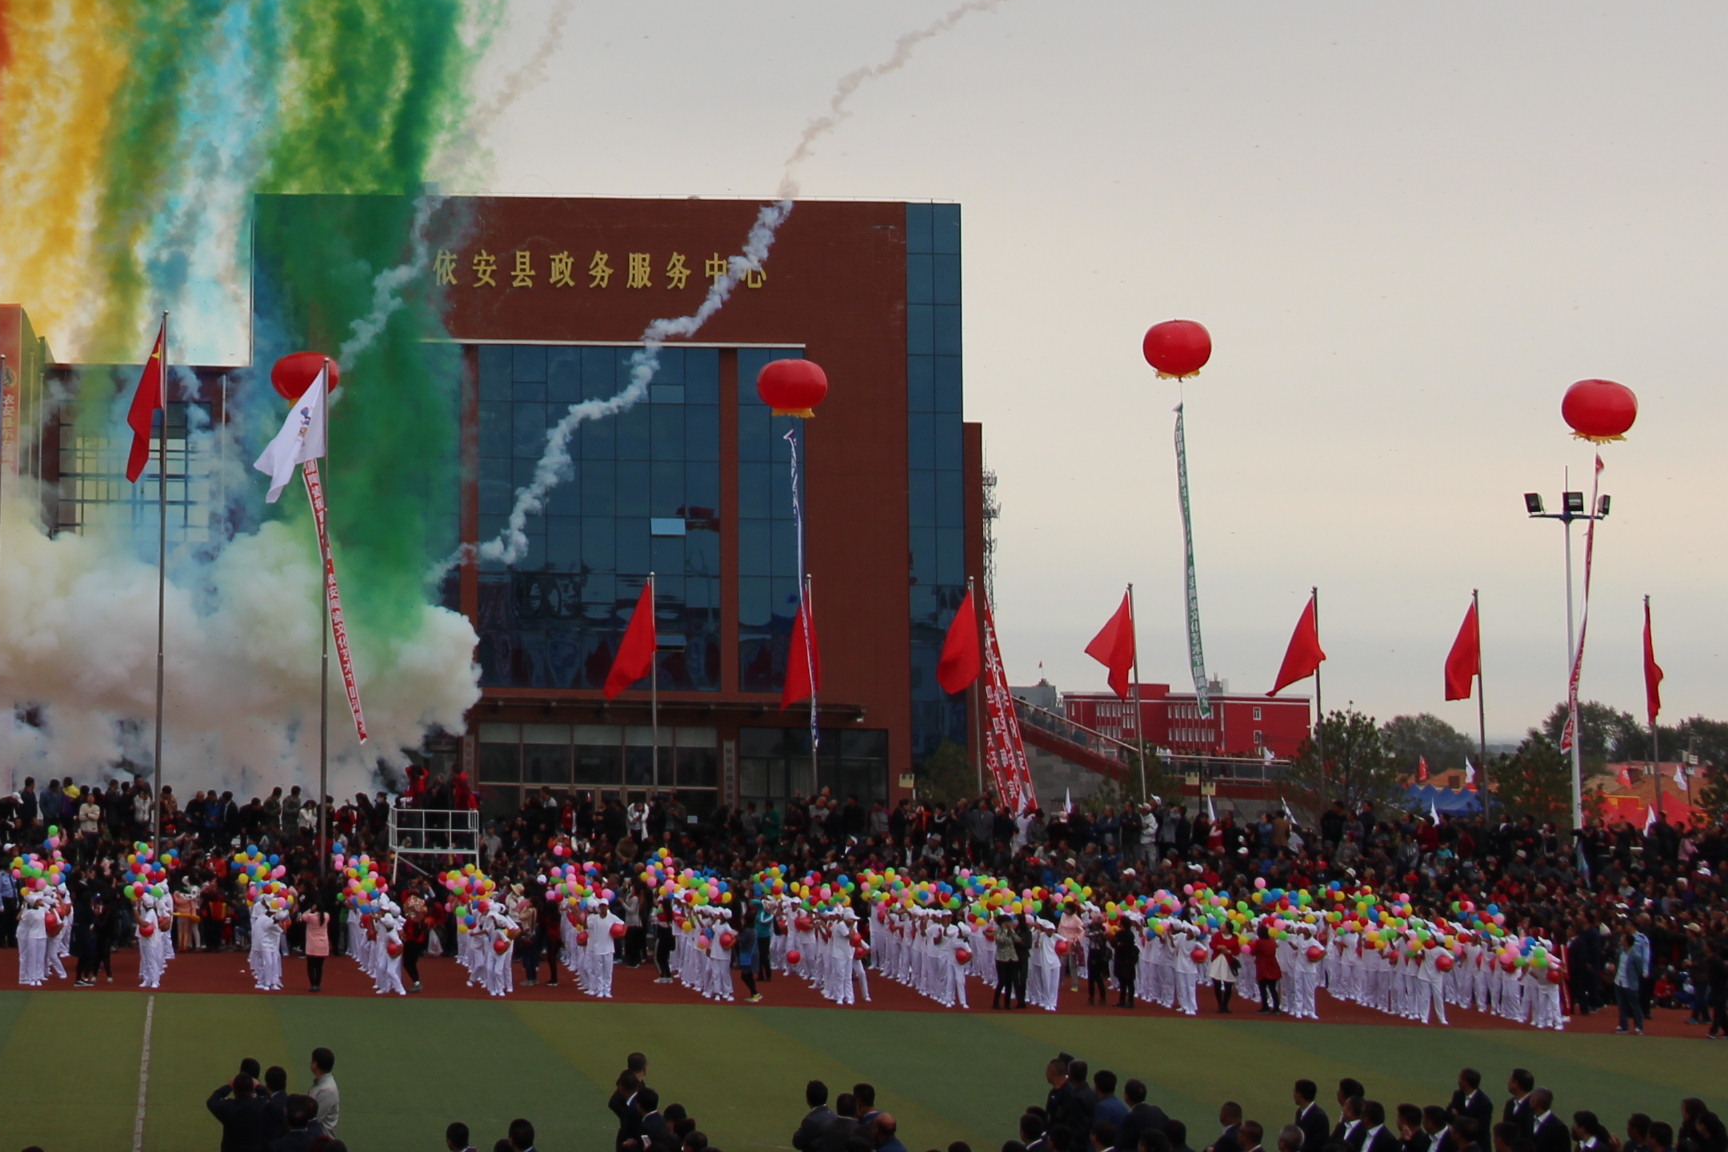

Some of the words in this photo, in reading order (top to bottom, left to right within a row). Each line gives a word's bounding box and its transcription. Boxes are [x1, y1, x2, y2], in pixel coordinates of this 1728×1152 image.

[434, 250, 767, 289] 依安县政务服务中心
